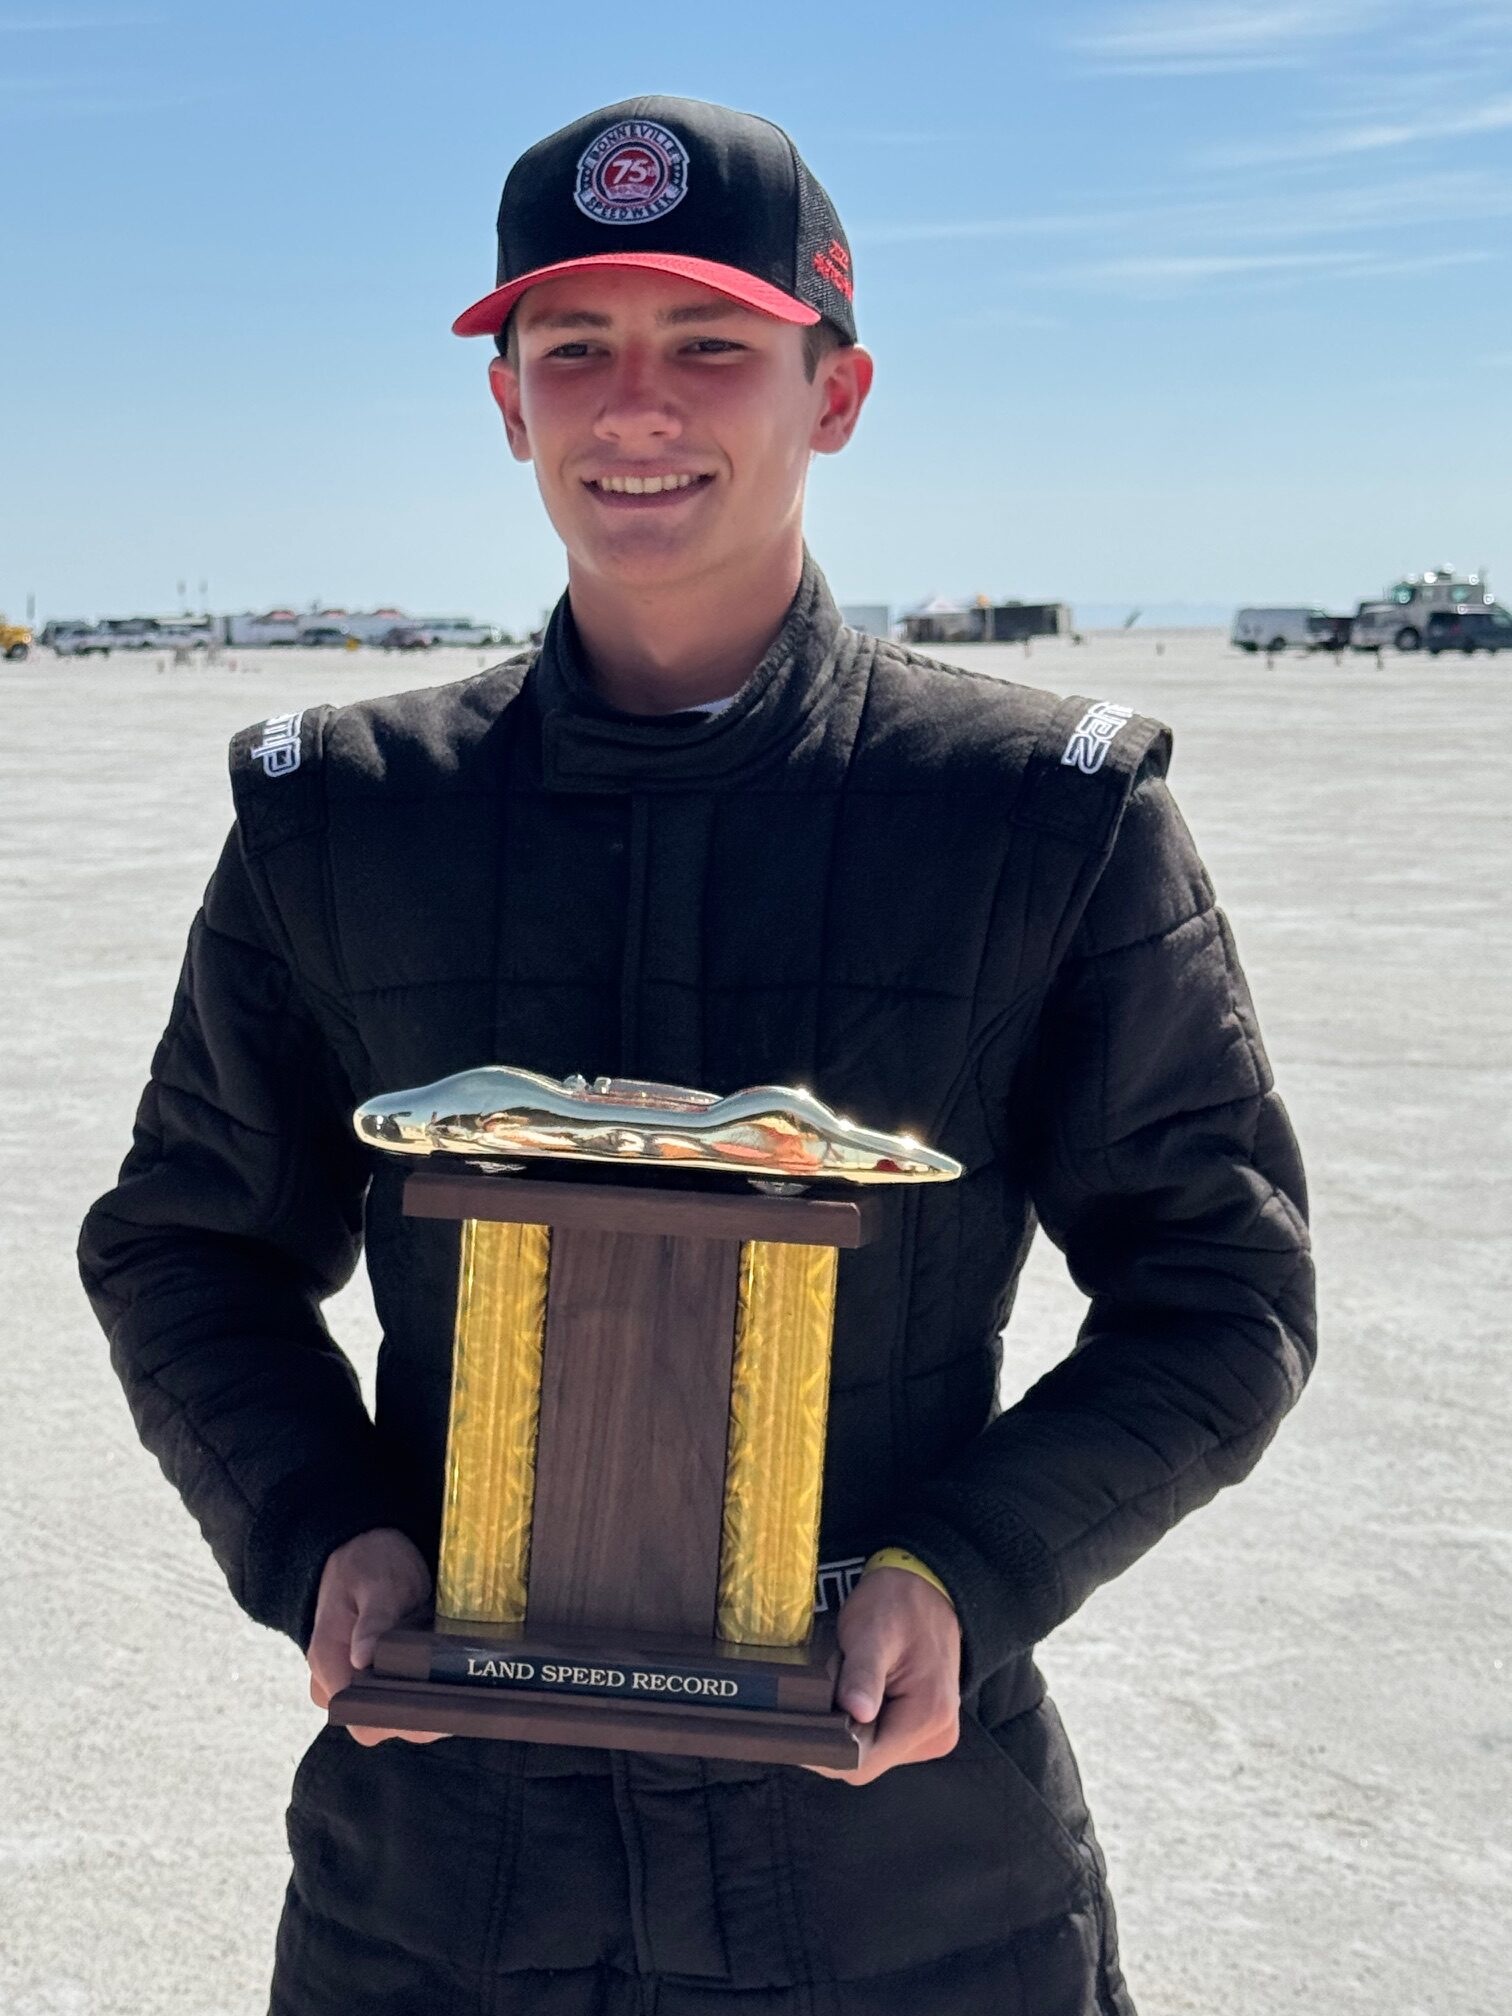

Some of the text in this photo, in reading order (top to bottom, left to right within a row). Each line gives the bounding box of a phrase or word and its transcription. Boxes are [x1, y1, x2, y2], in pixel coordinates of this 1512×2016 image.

[588, 122, 679, 161] BONNEVILLE
[585, 192, 676, 220] SPEEDWEEK
[1060, 701, 1134, 775] zam
[467, 1658, 738, 1697] LAND SPEED RECORD
